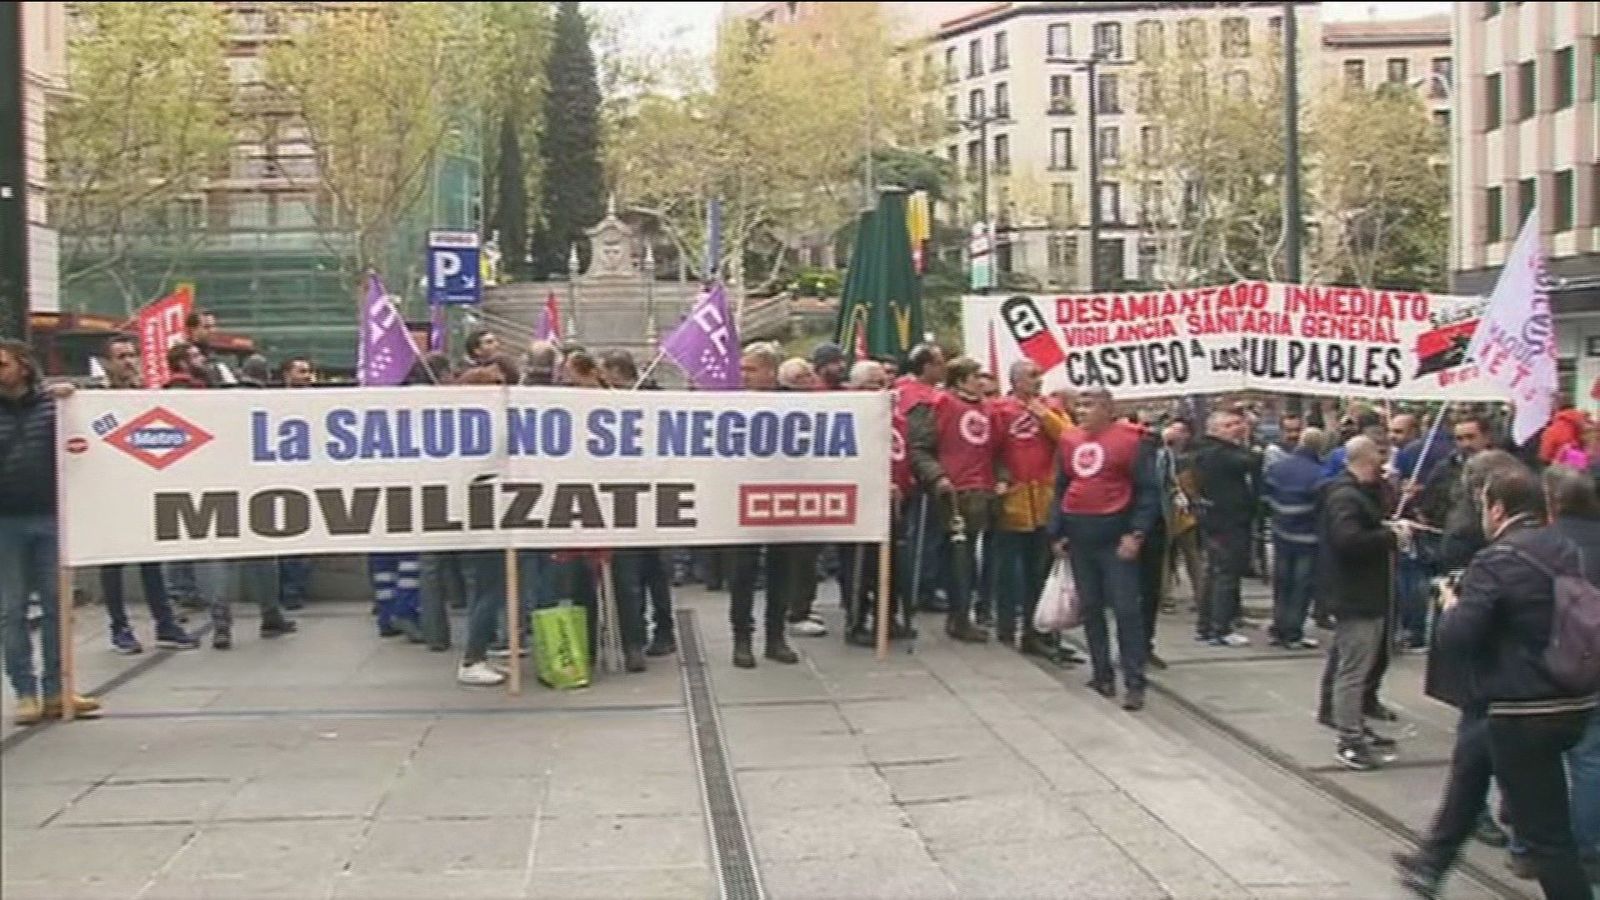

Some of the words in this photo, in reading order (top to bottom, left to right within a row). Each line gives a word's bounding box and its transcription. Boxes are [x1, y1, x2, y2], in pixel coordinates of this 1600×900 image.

[434, 251, 461, 288] P
[1056, 283, 1268, 324] DESAMIANTADO
[1285, 286, 1429, 322] INMEDIATO
[1063, 318, 1176, 347] VIGILANCIA
[1187, 311, 1292, 336] SANITARIA
[1301, 314, 1401, 344] GENERAL
[1066, 340, 1190, 387] CASTIGO
[1211, 347, 1240, 371] LOS
[1241, 338, 1403, 388] ULPABLES
[92, 412, 119, 435] en
[251, 410, 311, 462] La
[325, 408, 492, 460] SALUD
[507, 408, 572, 458] NO
[586, 409, 644, 458] SE
[656, 410, 858, 458] NEGOCIA
[154, 473, 697, 541] MOVILÍZATE
[745, 491, 849, 519] CCOO
